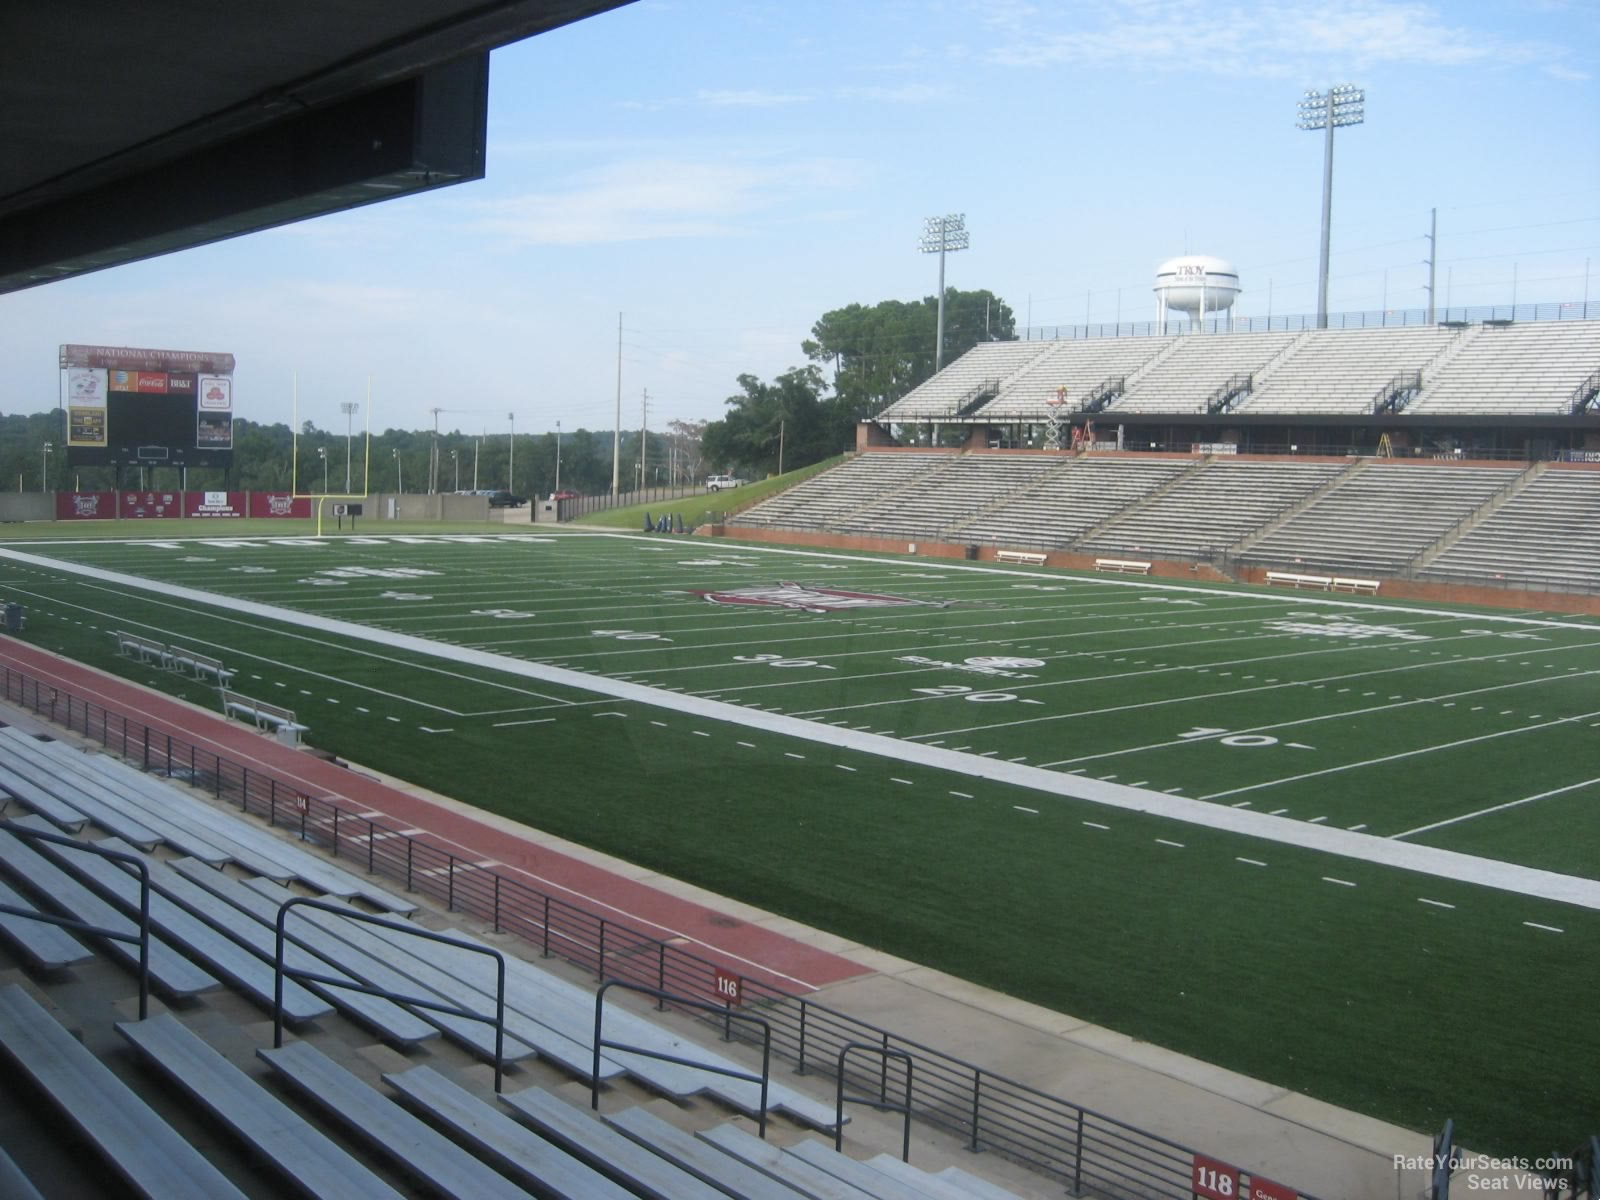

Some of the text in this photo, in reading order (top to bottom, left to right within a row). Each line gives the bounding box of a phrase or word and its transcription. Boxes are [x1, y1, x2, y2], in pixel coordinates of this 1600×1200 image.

[1176, 265, 1205, 275] TROY
[96, 348, 209, 362] NATIONAL CHAMPIONS
[198, 504, 234, 513] Champions
[911, 685, 1018, 702] 20
[1177, 727, 1279, 747] 10
[717, 976, 737, 997] 116
[1197, 1166, 1233, 1196] 118
